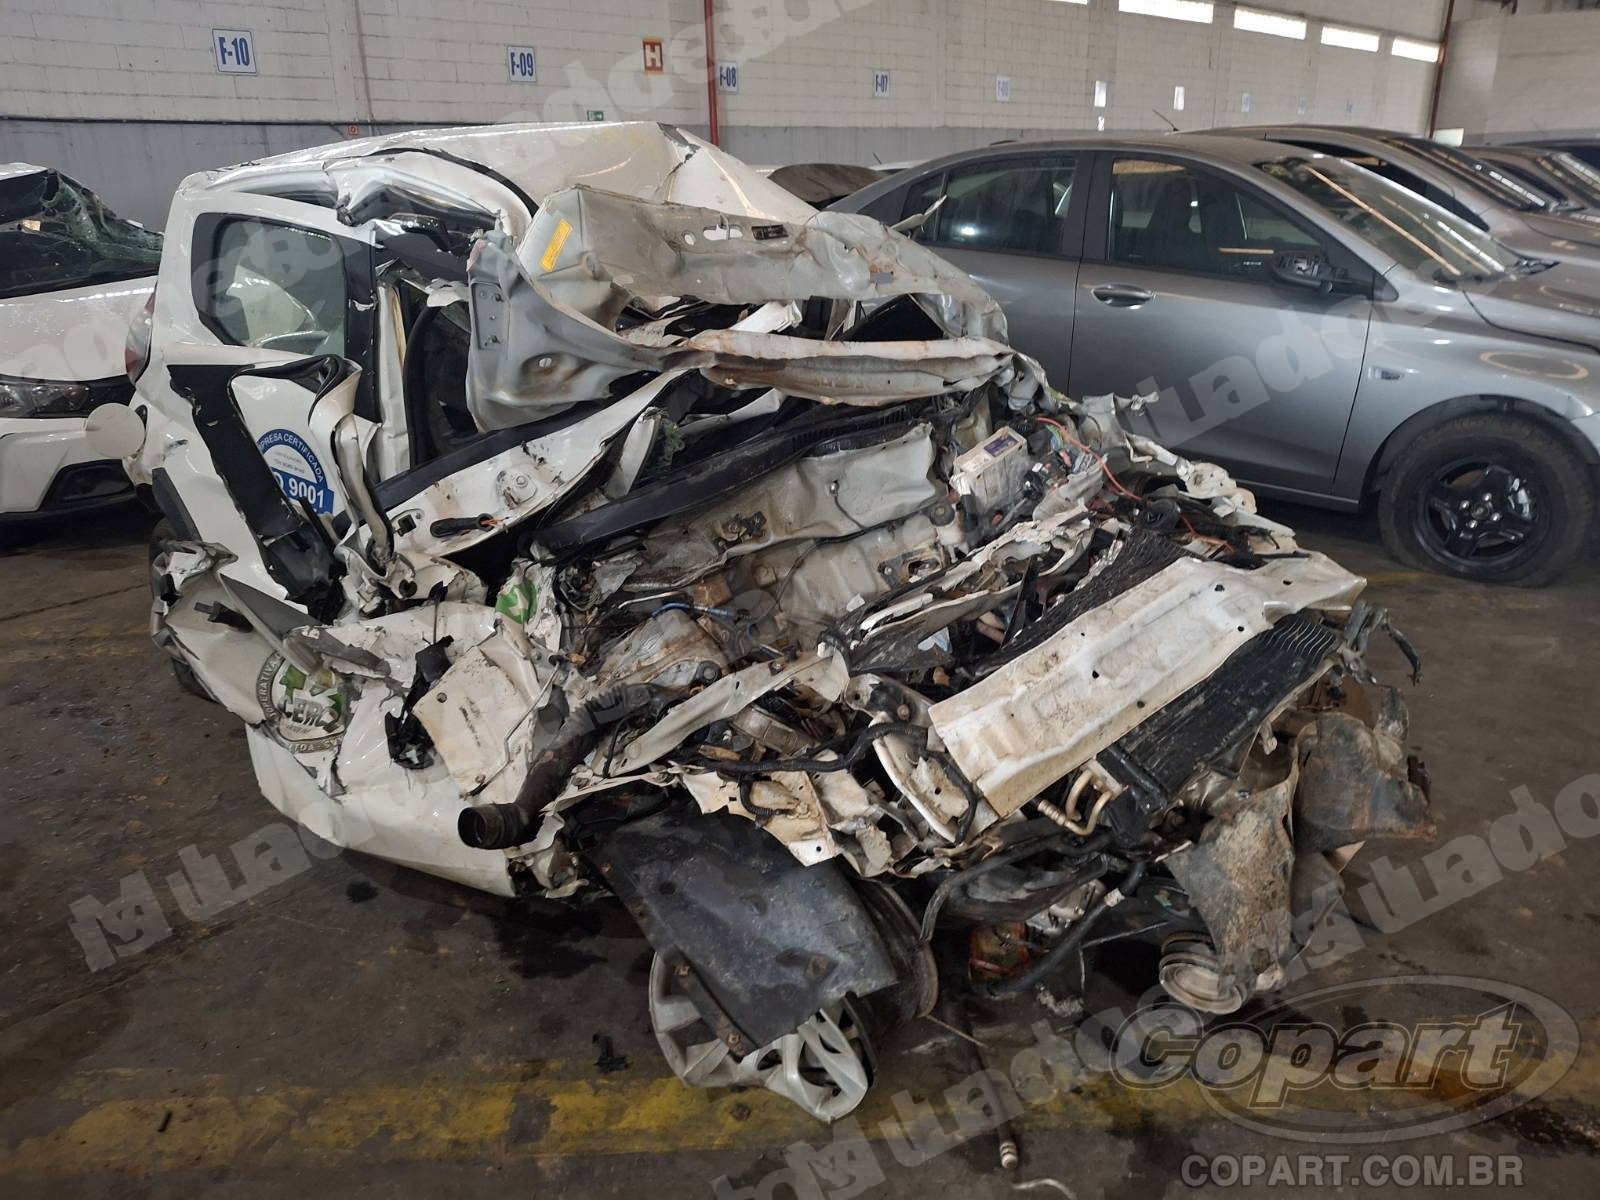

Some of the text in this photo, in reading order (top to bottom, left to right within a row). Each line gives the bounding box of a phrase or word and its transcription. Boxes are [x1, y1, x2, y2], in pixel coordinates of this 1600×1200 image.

[218, 37, 250, 66] F-10
[510, 52, 534, 76] F-09
[644, 44, 663, 68] H
[719, 66, 737, 87] F-08
[283, 434, 324, 482] CERTIFICADA
[288, 477, 324, 509] 9001
